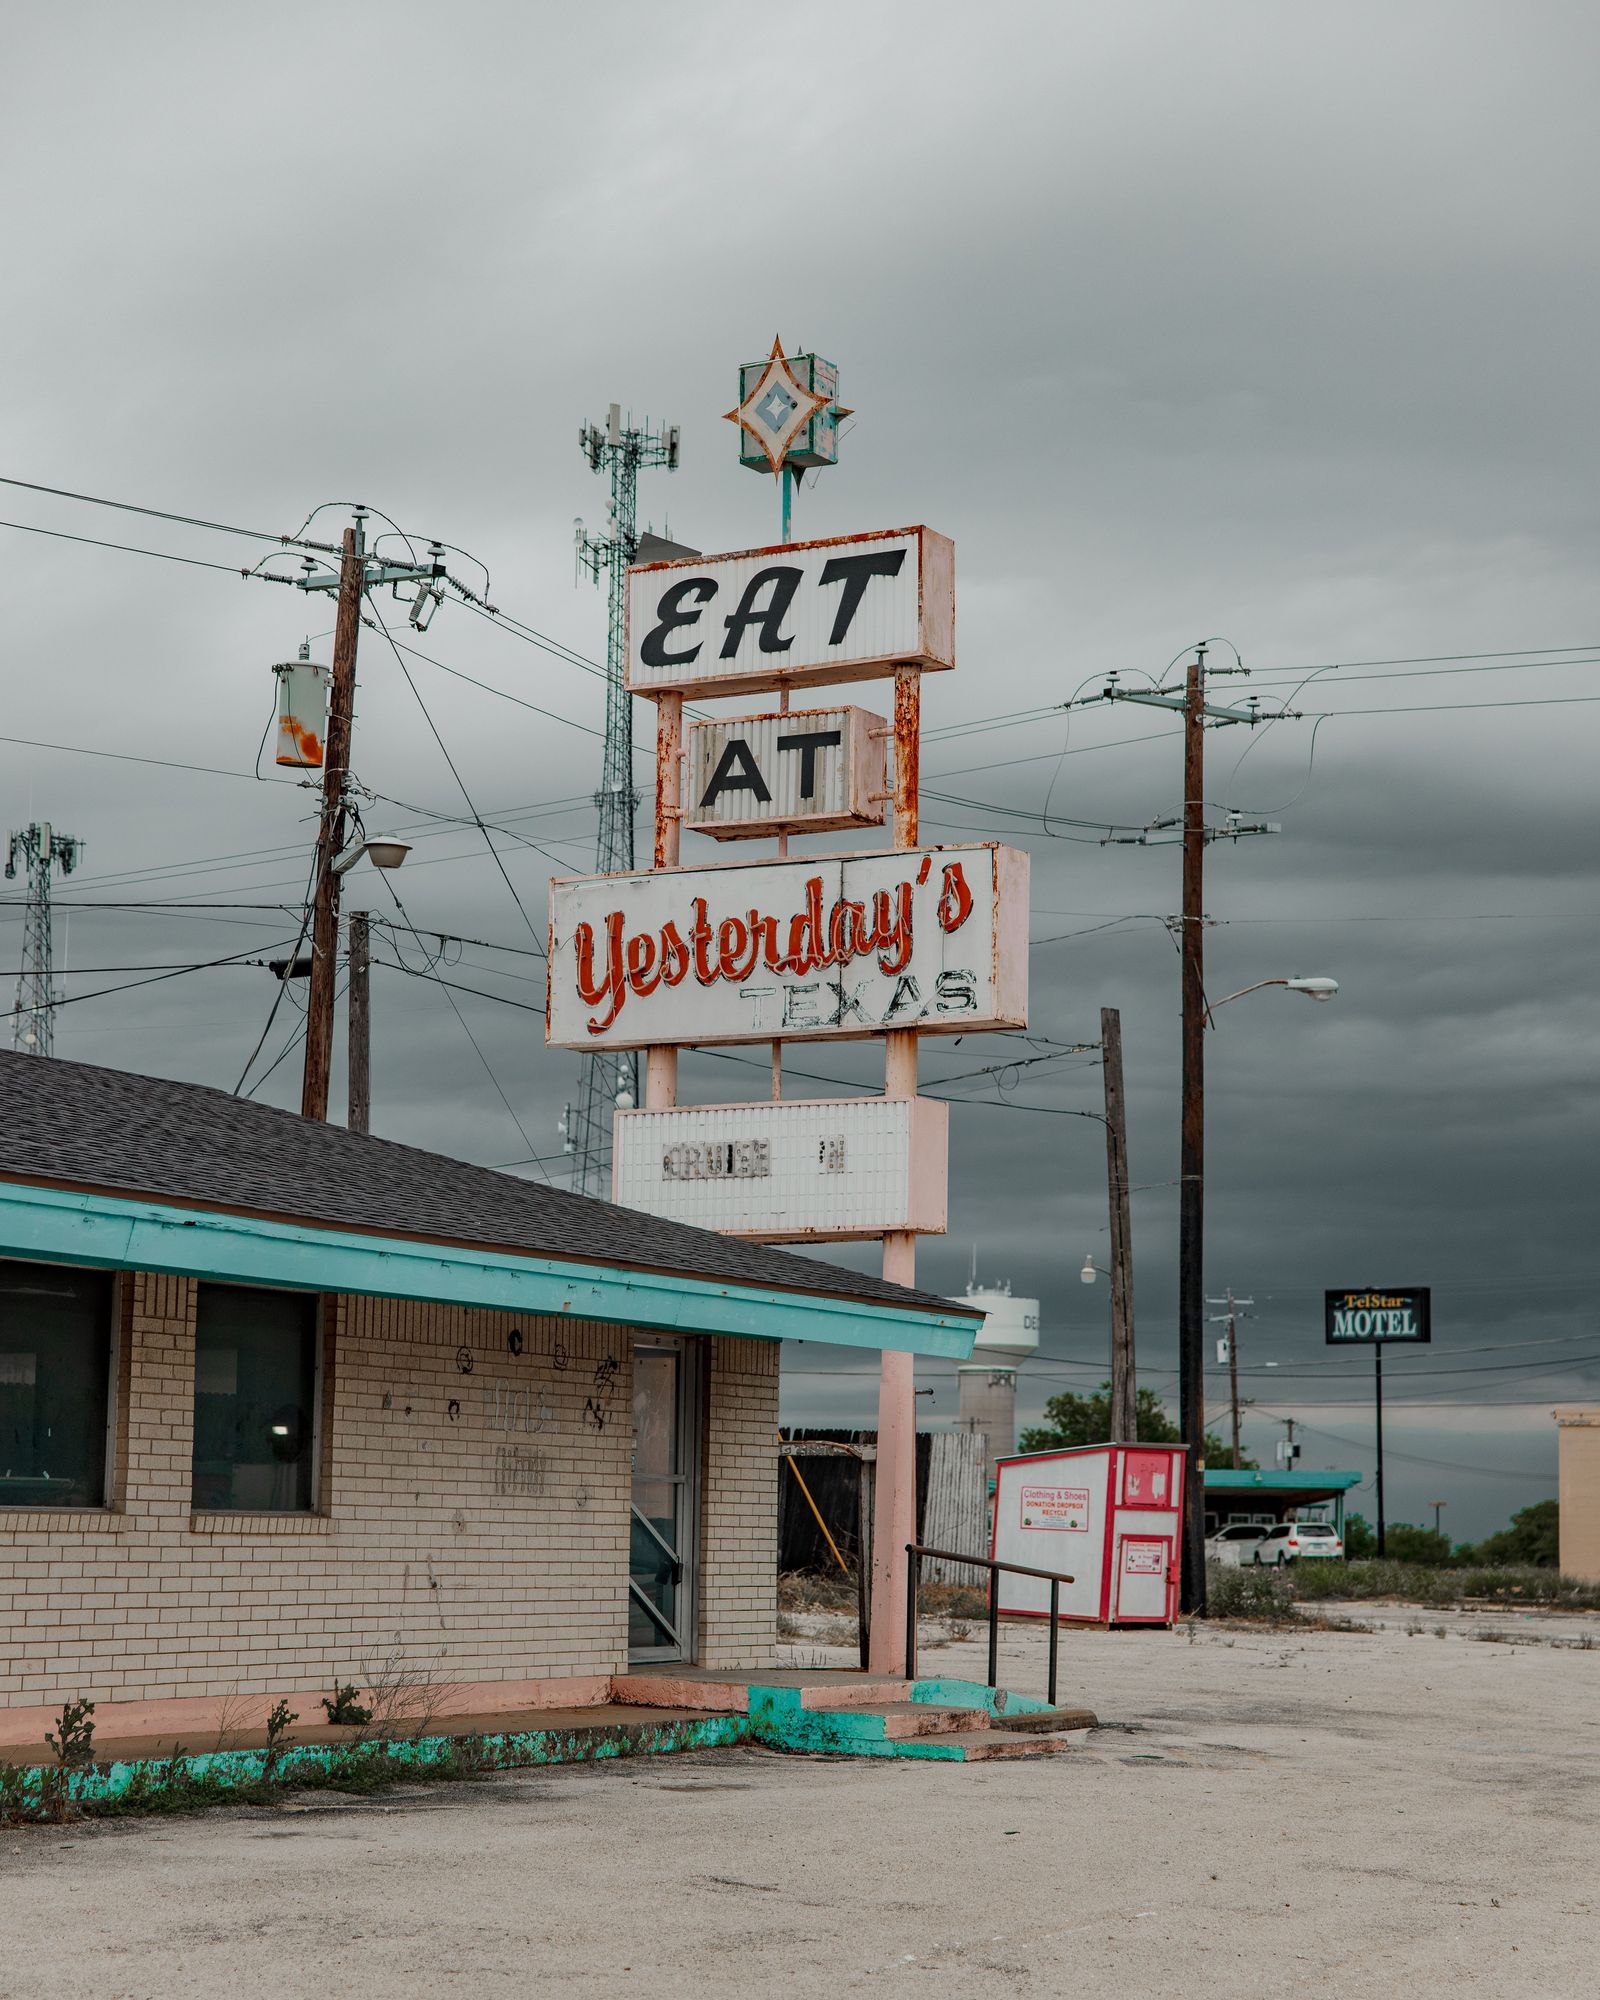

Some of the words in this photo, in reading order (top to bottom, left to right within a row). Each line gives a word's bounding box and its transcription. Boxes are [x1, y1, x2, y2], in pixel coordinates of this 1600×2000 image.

[641, 549, 907, 667] EAT
[700, 730, 841, 806] AT
[574, 855, 974, 1036] Yesterday's
[739, 969, 978, 1029] TEXAS
[1344, 1294, 1404, 1309] TelStar
[1333, 1310, 1417, 1337] MOTEL
[1024, 1490, 1055, 1501] Clothing
[1057, 1491, 1062, 1500] &
[1064, 1491, 1087, 1501] Shoes
[1042, 1509, 1068, 1517] RECYCLE
